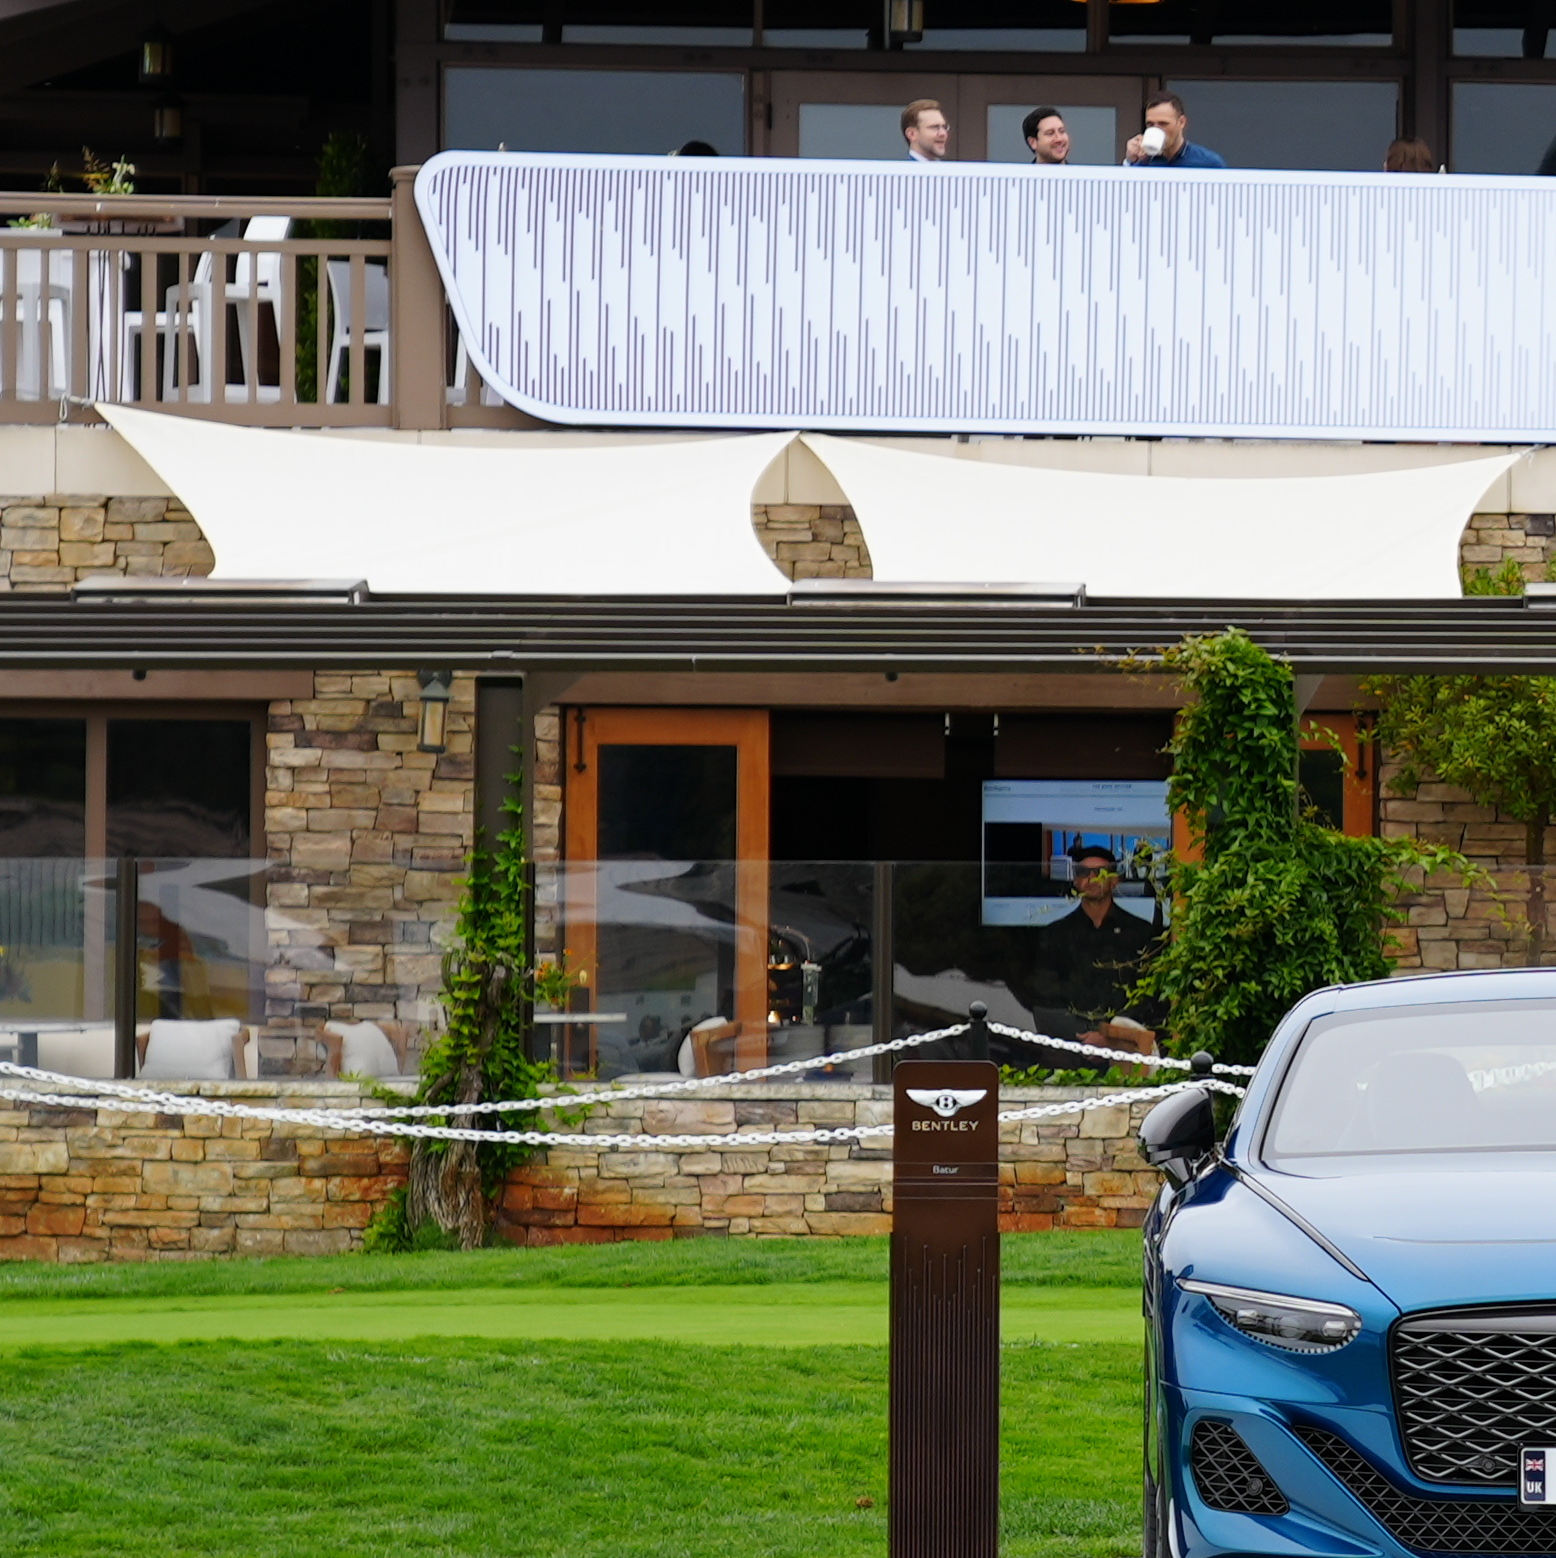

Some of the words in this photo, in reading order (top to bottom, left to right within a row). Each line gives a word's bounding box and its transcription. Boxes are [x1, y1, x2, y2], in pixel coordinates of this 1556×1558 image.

[911, 1120, 980, 1132] BENTLEY
[933, 1165, 959, 1174] Batur
[1526, 1481, 1543, 1494] UK
